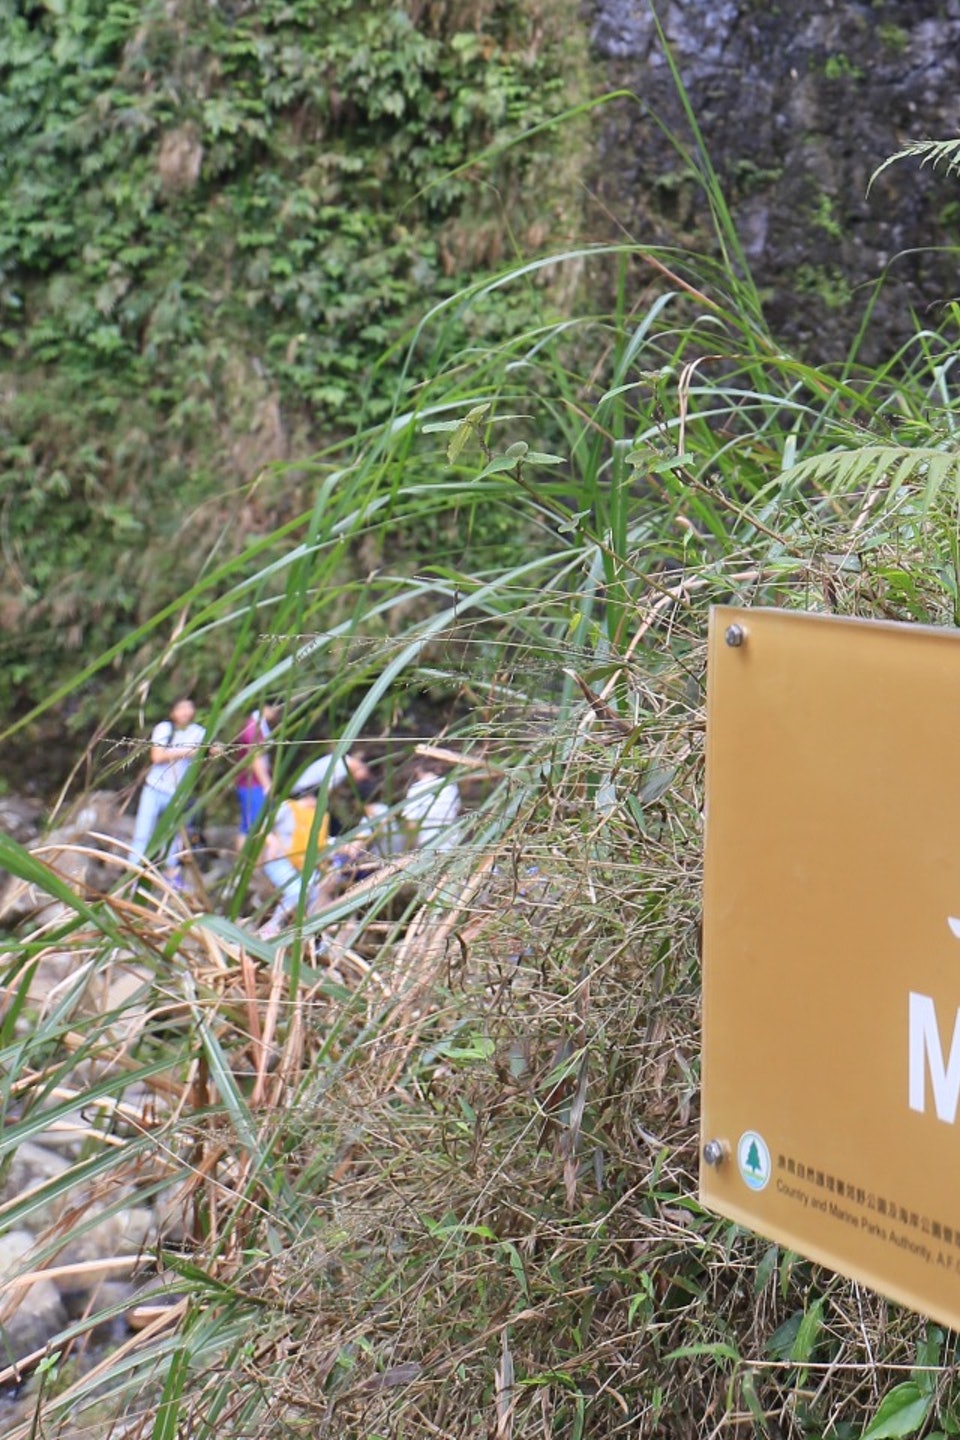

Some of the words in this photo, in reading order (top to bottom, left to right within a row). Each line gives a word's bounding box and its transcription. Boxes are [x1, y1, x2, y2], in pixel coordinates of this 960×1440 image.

[776, 1178, 809, 1208] Country
[811, 1197, 828, 1213] and
[829, 1201, 860, 1228] Marine
[861, 1216, 887, 1240] Parks
